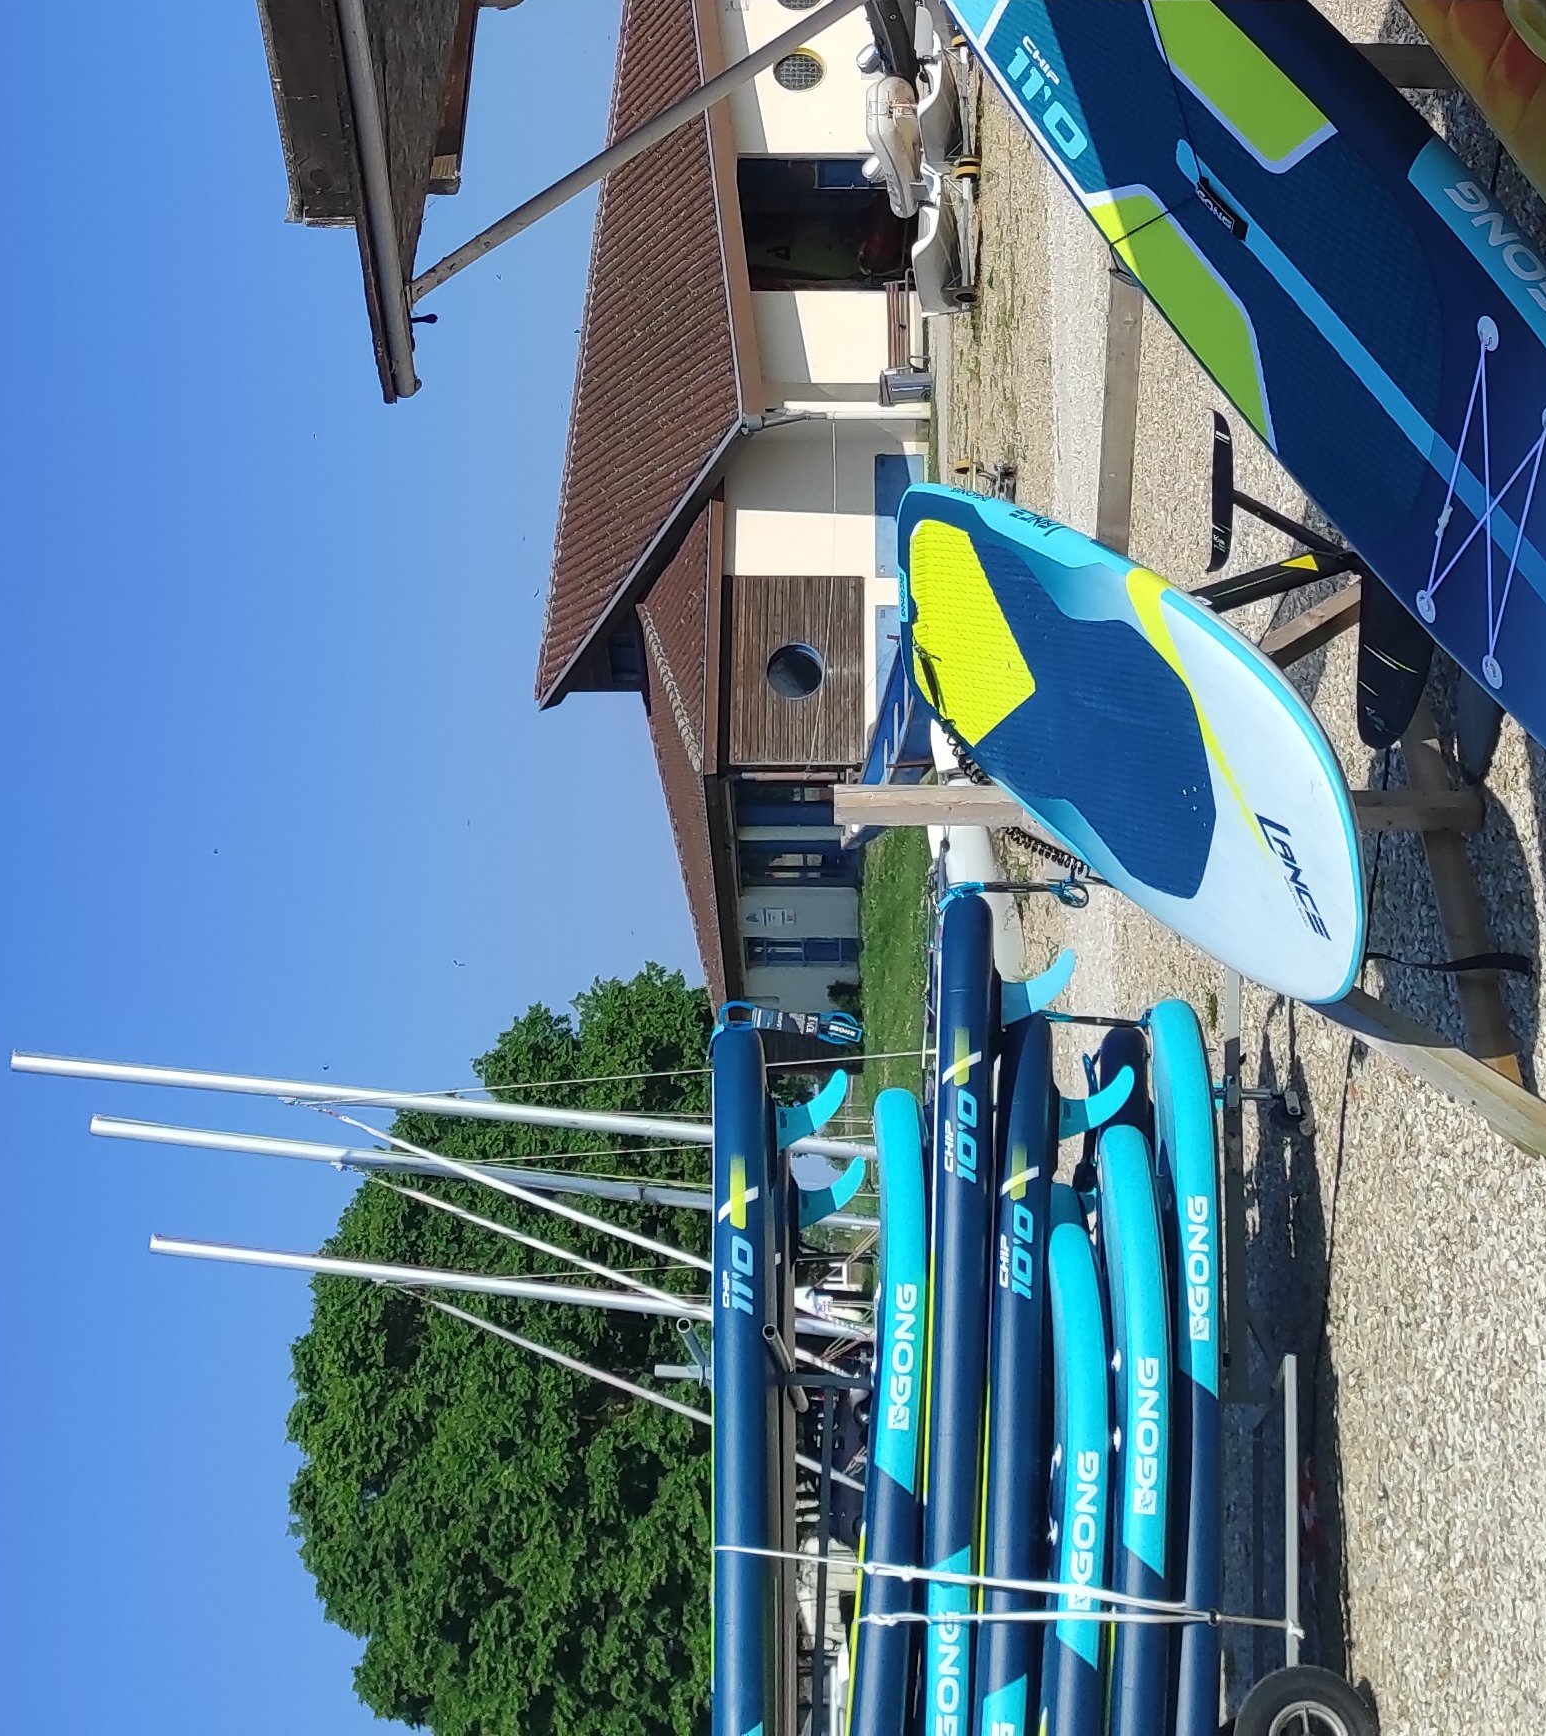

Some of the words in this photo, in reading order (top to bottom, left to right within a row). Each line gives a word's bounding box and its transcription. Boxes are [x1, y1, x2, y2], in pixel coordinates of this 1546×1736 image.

[1021, 35, 1061, 86] CHIP
[1194, 186, 1233, 230] GONG
[1253, 812, 1332, 942] LANCE
[944, 1119, 954, 1173] CHIP
[722, 1269, 730, 1308] CHIP
[999, 1234, 1010, 1288] CHIP
[1187, 1195, 1210, 1316] GONG
[887, 1282, 918, 1404] GONG
[1134, 1356, 1160, 1488] GONG
[1070, 1450, 1100, 1583] GONG
